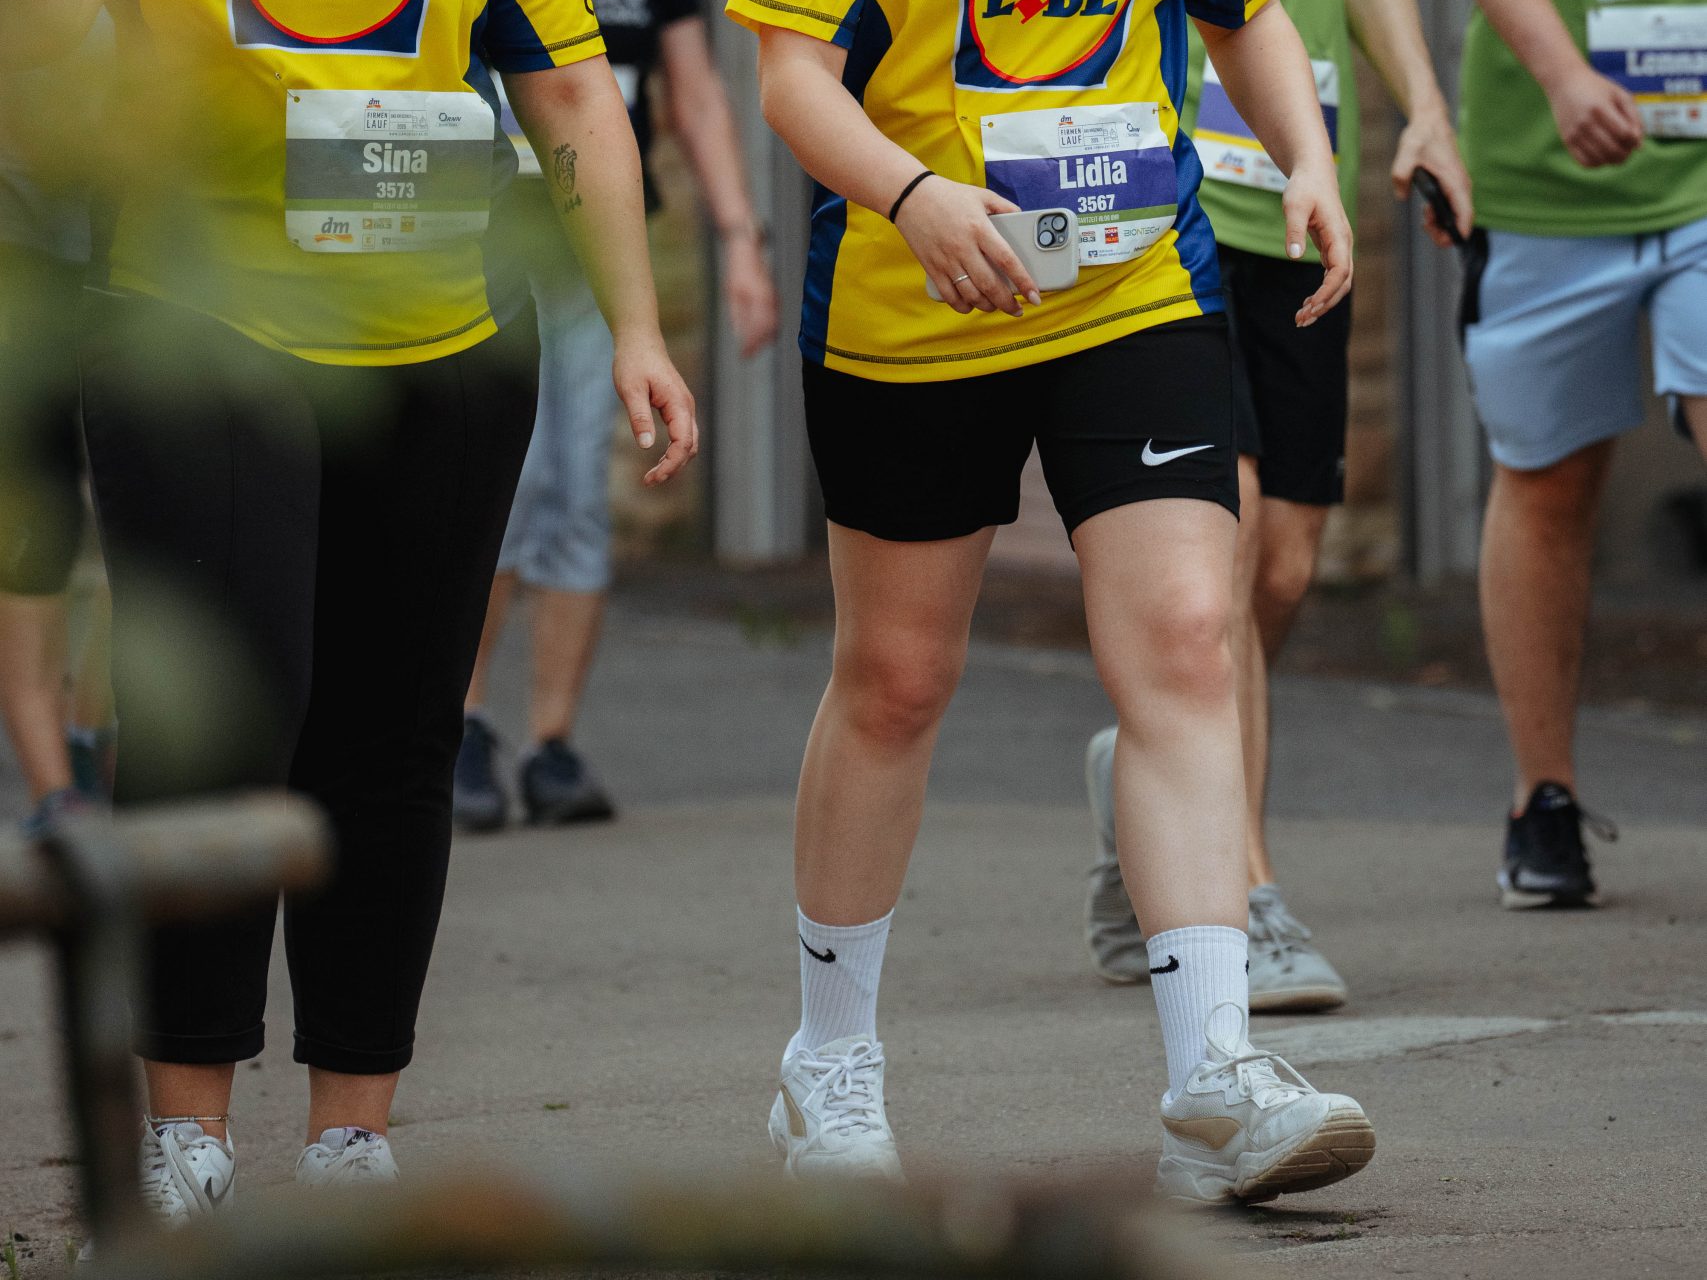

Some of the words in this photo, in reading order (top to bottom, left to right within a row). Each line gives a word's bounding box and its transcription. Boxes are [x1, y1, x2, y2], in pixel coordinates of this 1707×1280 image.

[366, 120, 388, 129] LAUF
[1061, 136, 1082, 146] LAUF
[362, 142, 428, 174] Sina
[1059, 155, 1128, 190] Lidia
[376, 181, 416, 199] 3573
[1077, 193, 1116, 213] 3567
[320, 217, 350, 234] dm
[1123, 226, 1160, 237] BIONTECH
